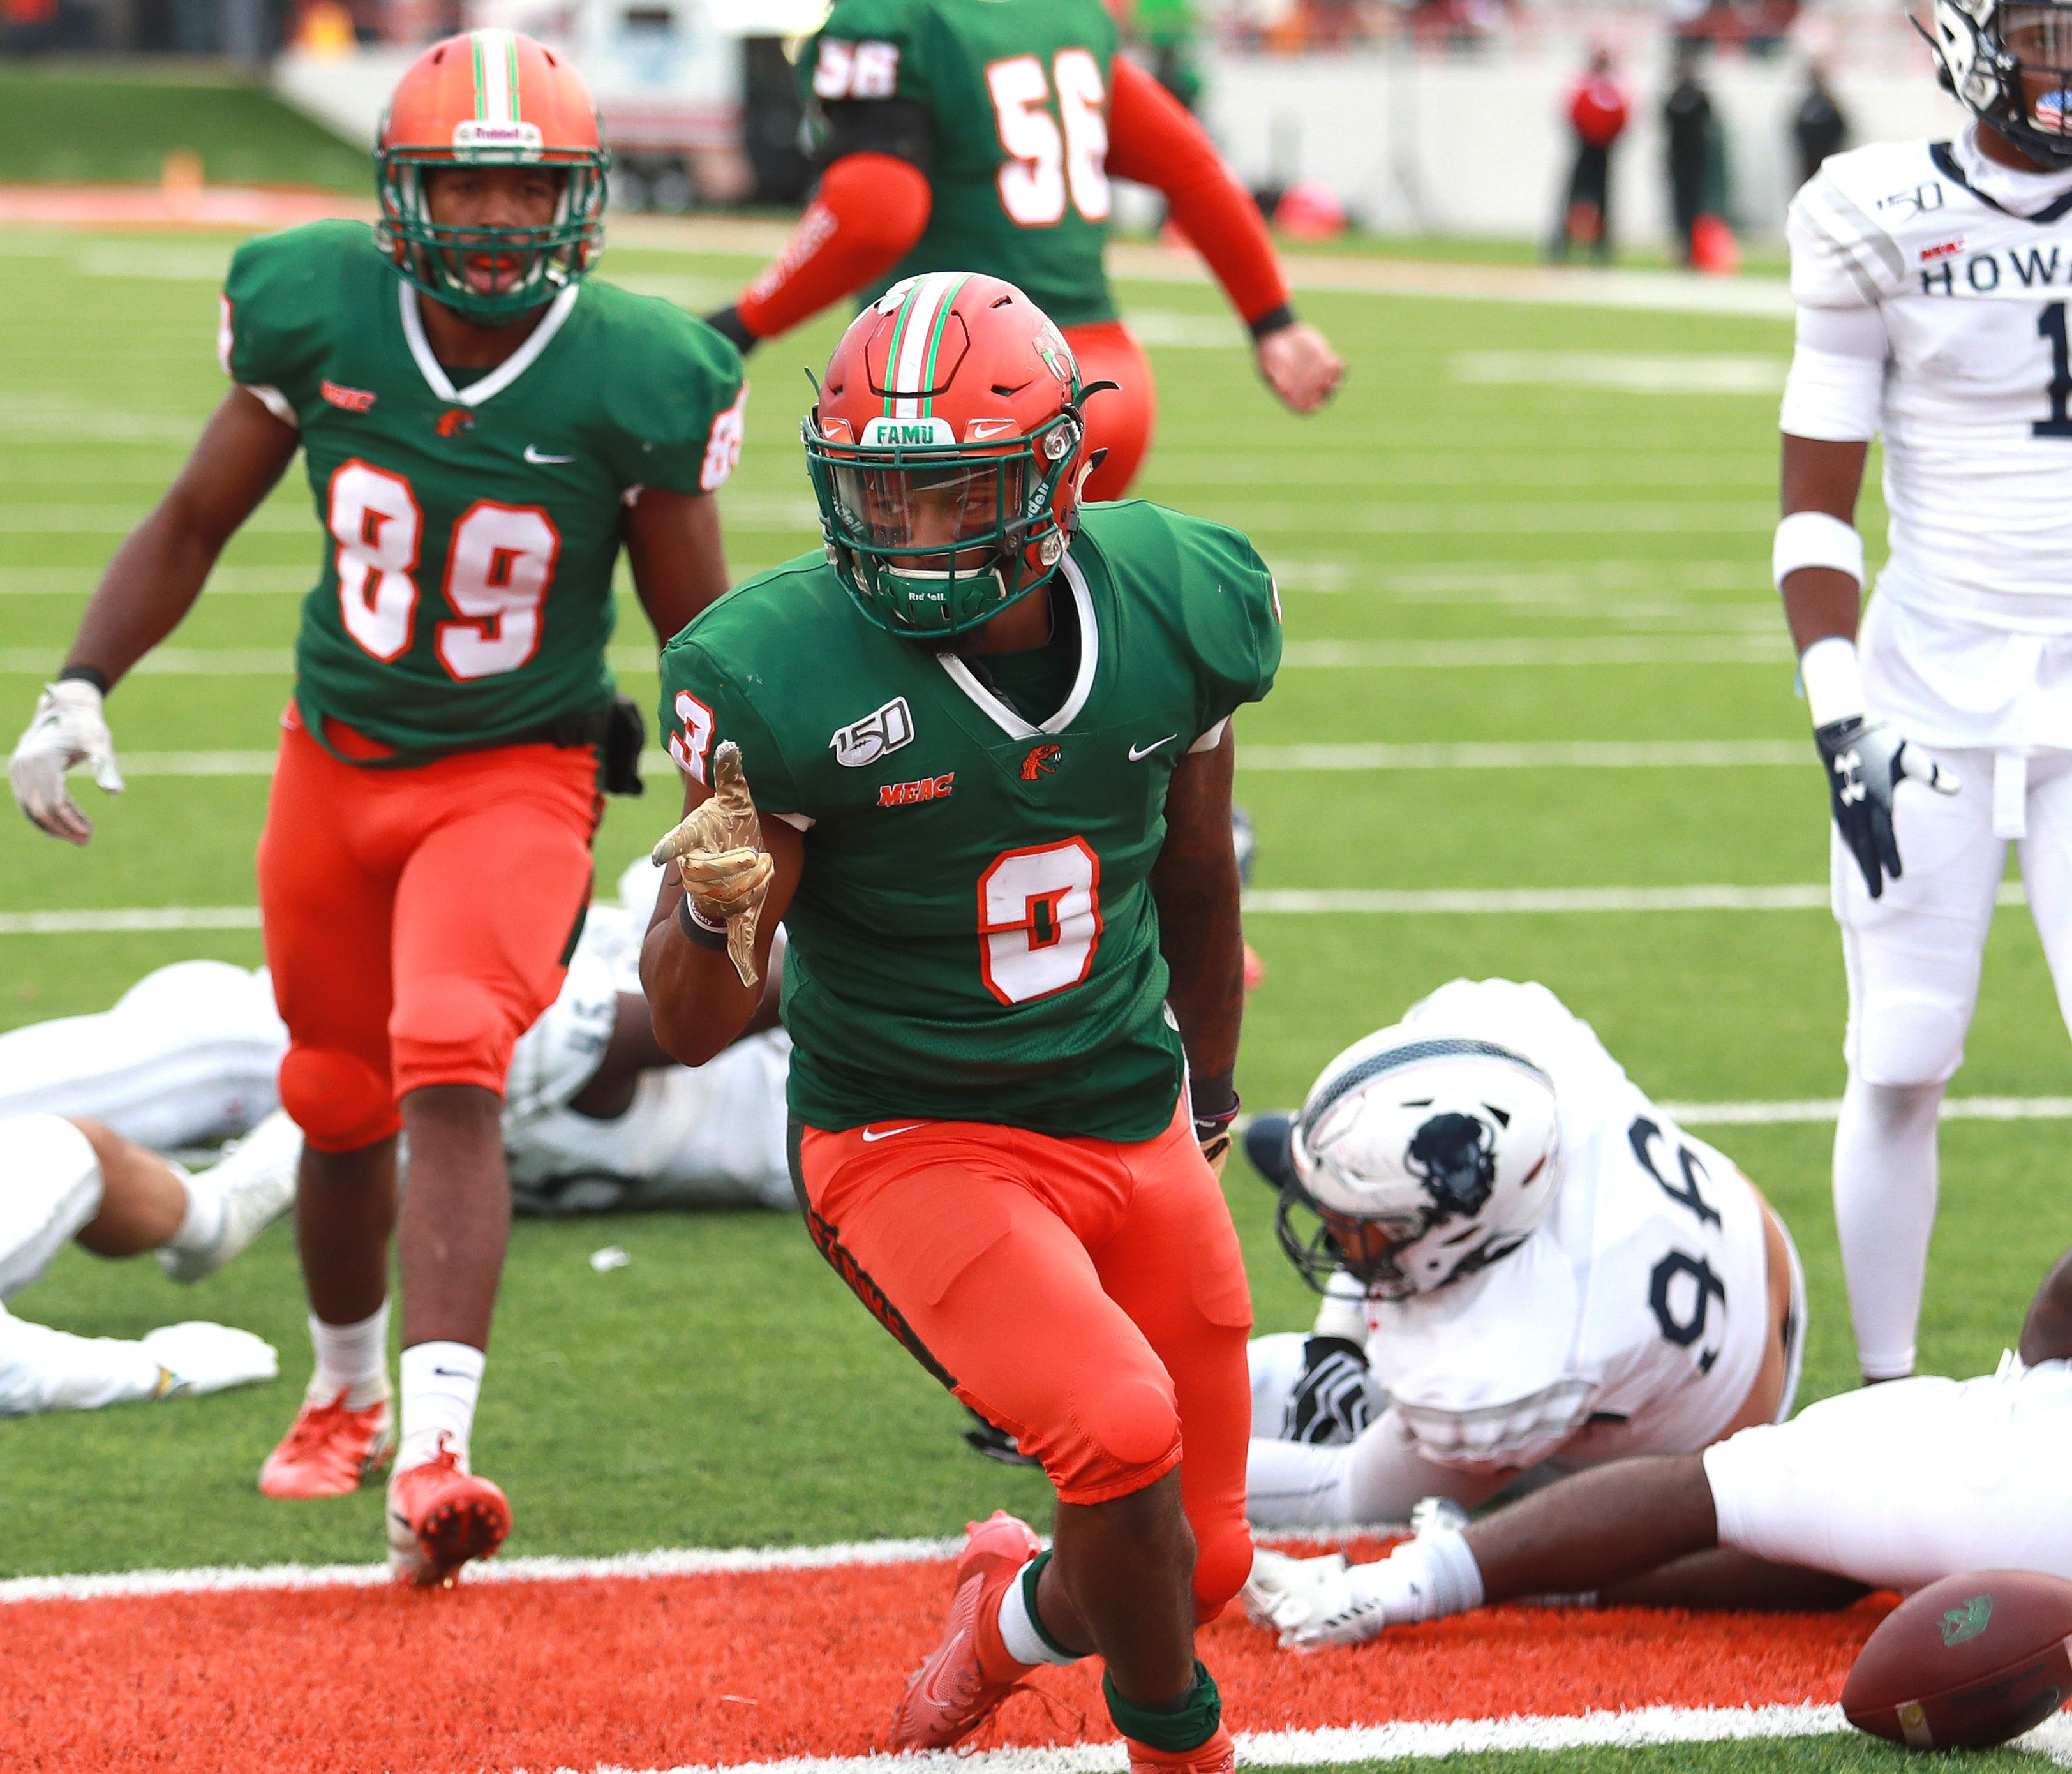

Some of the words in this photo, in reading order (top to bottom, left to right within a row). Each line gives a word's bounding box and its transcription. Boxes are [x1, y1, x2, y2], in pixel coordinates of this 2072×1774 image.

[814, 36, 901, 100] 56
[983, 47, 1112, 228] 56
[1922, 246, 2072, 295] HOW
[877, 426, 933, 444] FAMU
[327, 457, 561, 682] 89
[669, 690, 716, 786] 3
[835, 698, 913, 766] 150
[877, 771, 955, 807] MEAC
[977, 835, 1102, 1006] 3
